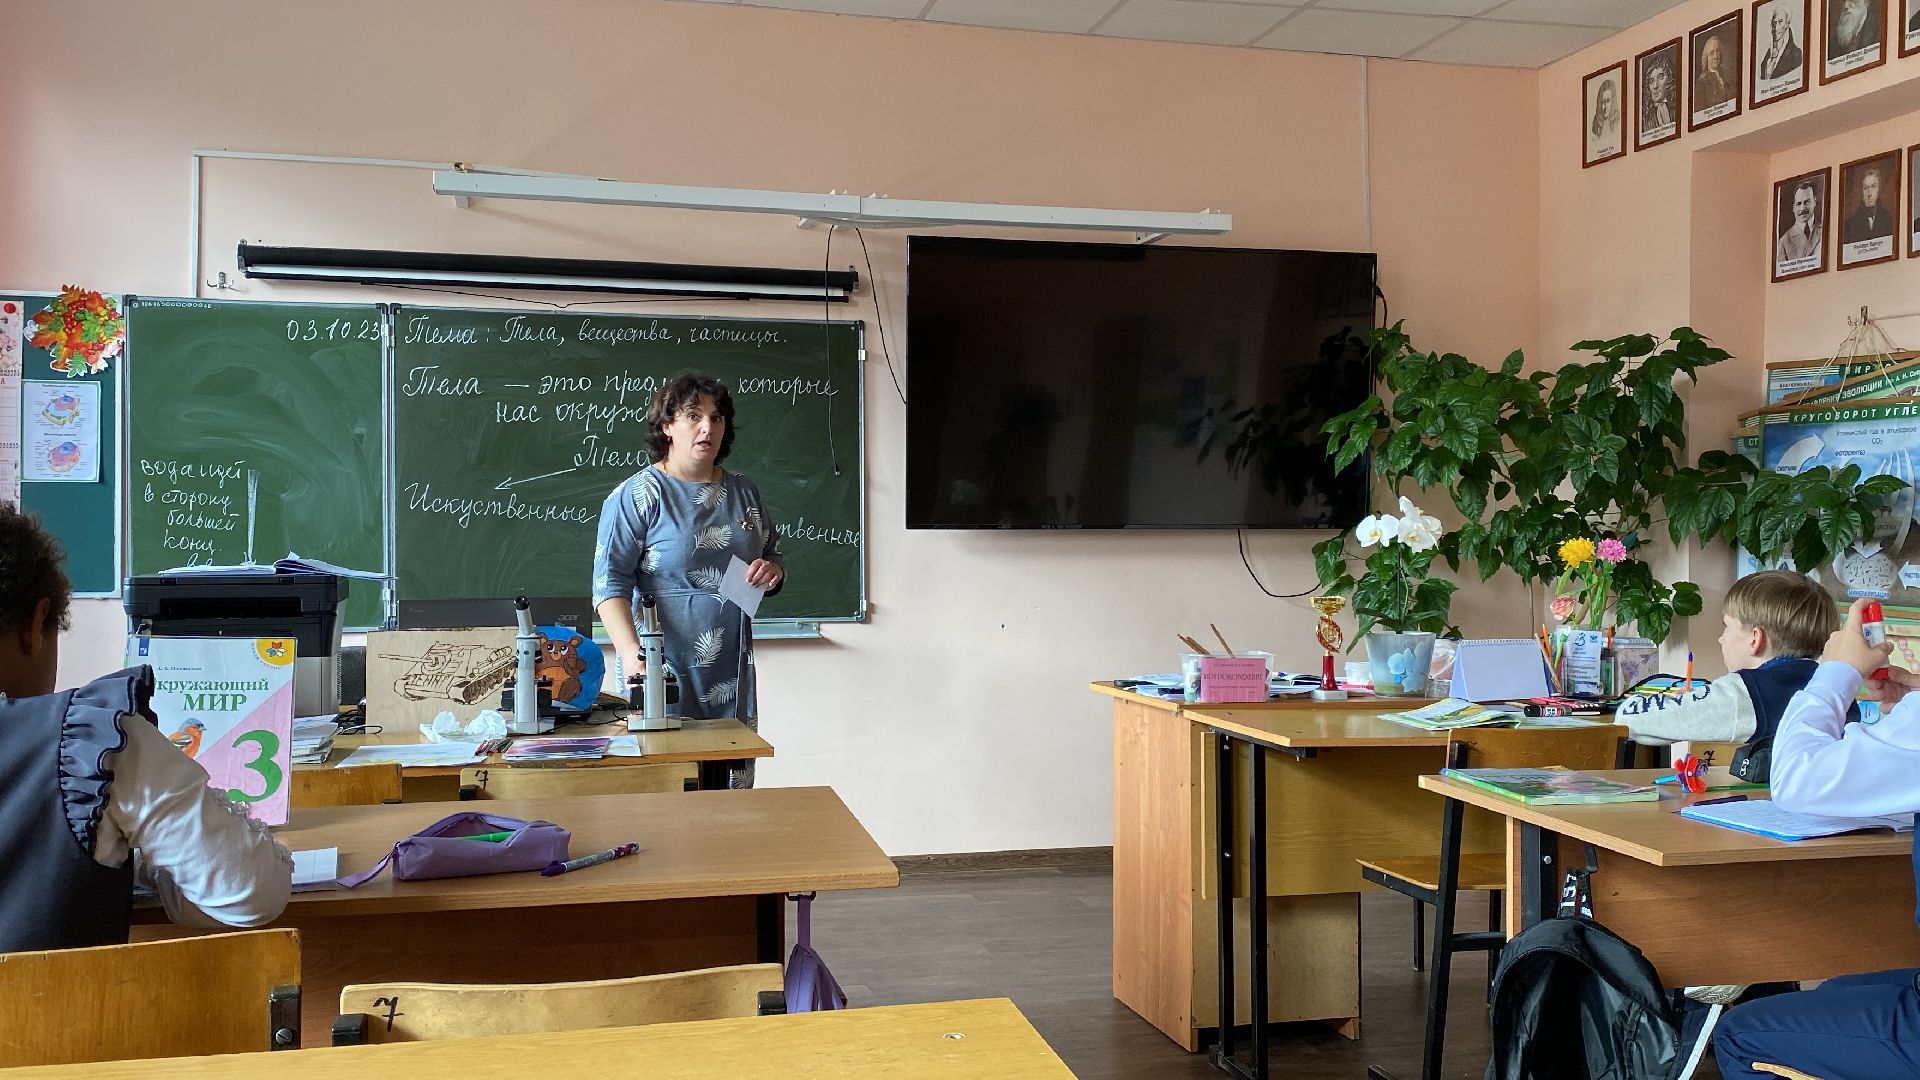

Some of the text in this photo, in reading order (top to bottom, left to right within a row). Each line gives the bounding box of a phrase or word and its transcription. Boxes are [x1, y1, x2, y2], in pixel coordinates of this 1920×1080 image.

[287, 318, 381, 342] 03.10.23
[403, 365, 484, 396] Тела
[538, 375, 592, 395] это
[738, 375, 840, 406] которые
[496, 401, 650, 433] нас окруж
[1793, 405, 1918, 423] КРУГОВОРОТ УГЛЕ
[144, 482, 155, 502] в
[404, 482, 597, 529] Искуственные
[167, 508, 240, 531] большей
[157, 678, 269, 694] кружающий
[182, 694, 248, 712] МИР
[227, 729, 283, 803] 3
[475, 769, 489, 790] 7
[372, 996, 404, 1032] 7
